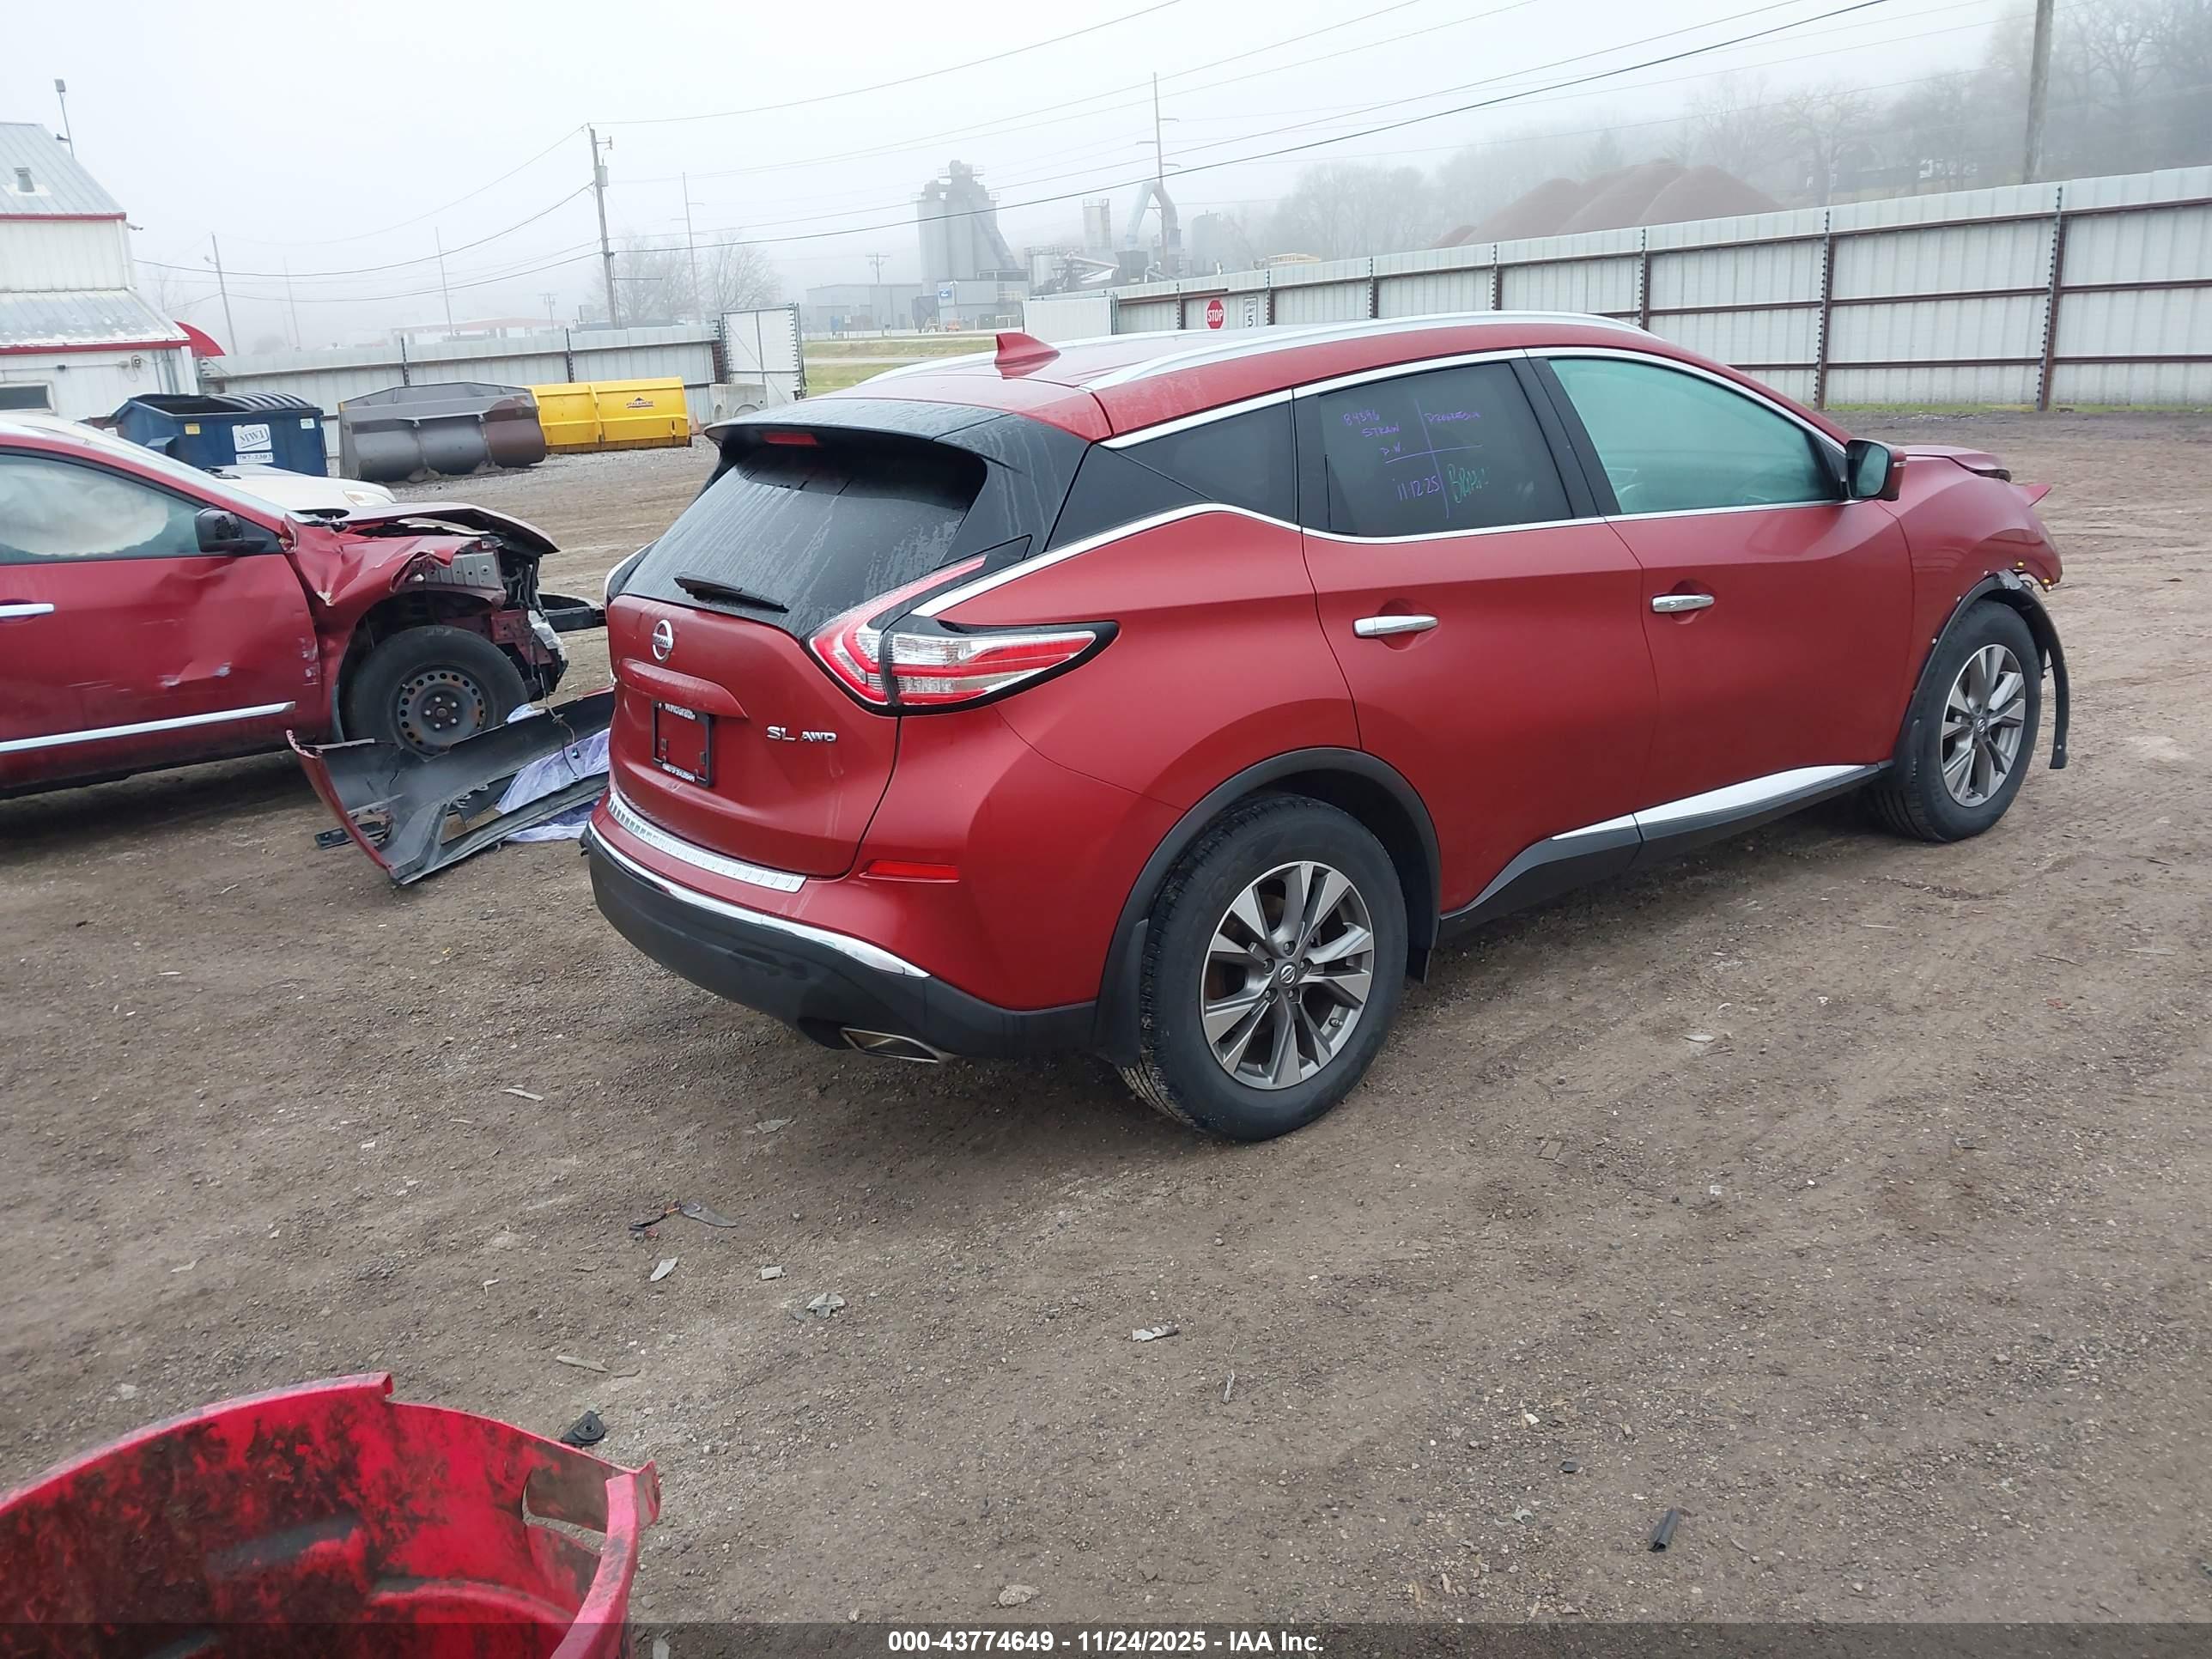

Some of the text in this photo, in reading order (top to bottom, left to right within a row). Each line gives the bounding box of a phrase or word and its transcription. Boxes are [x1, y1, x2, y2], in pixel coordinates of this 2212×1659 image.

[1207, 309, 1224, 323] STOP
[1248, 315, 1254, 326] 5
[767, 726, 837, 742] SL AWD
